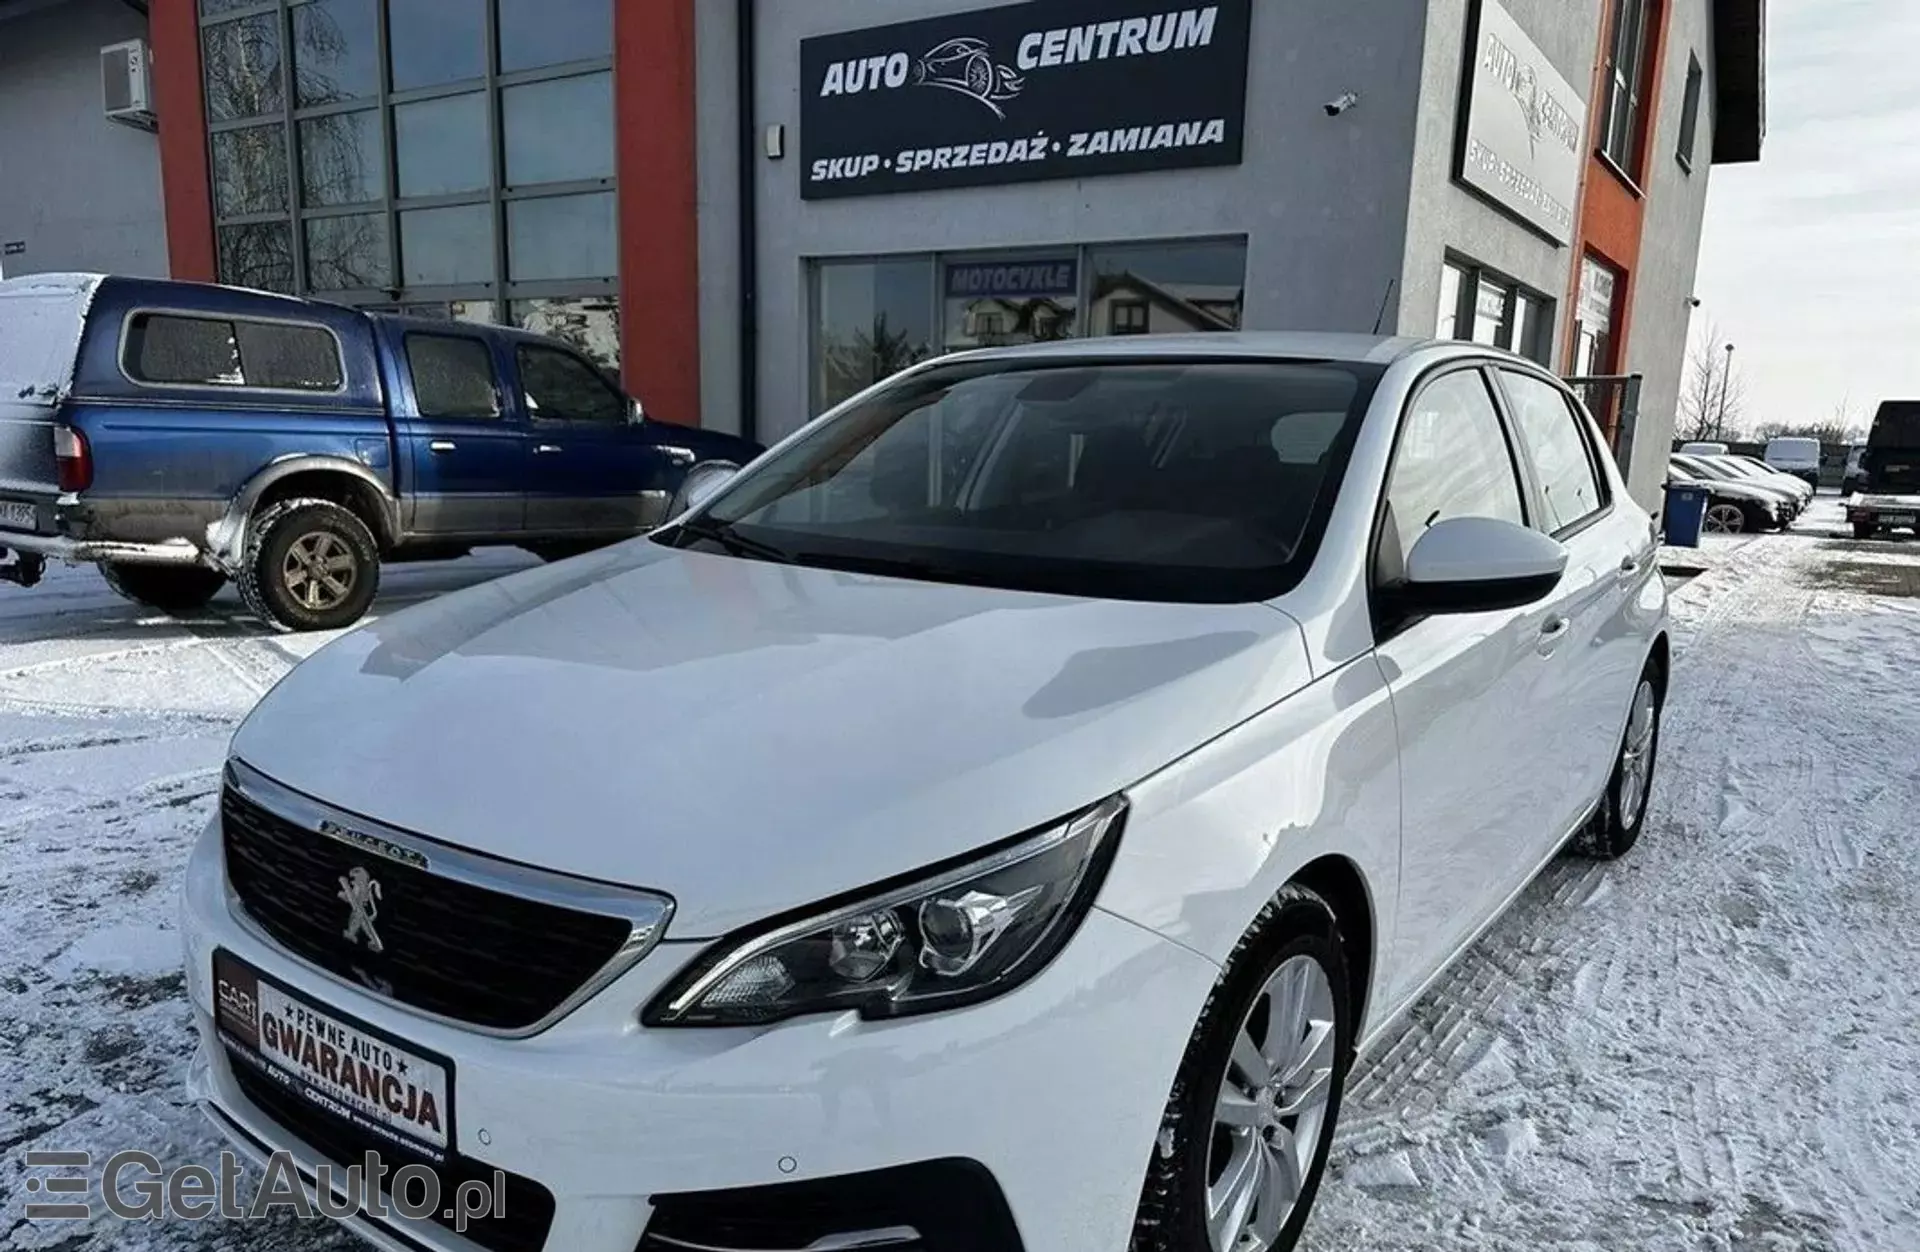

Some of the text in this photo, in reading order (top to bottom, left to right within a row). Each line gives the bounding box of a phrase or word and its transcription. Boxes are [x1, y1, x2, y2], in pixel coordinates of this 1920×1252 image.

[820, 6, 1218, 97] AUTO CENTRUM
[1484, 33, 1517, 92] AUTO
[811, 119, 1225, 181] SKUP SPRZEDAŻ ZAMIANA
[952, 264, 1070, 291] MOTOCYKLE
[296, 1008, 346, 1050] PEWNE
[350, 1036, 392, 1071] AUTO
[262, 1011, 441, 1134] GWARANCJA
